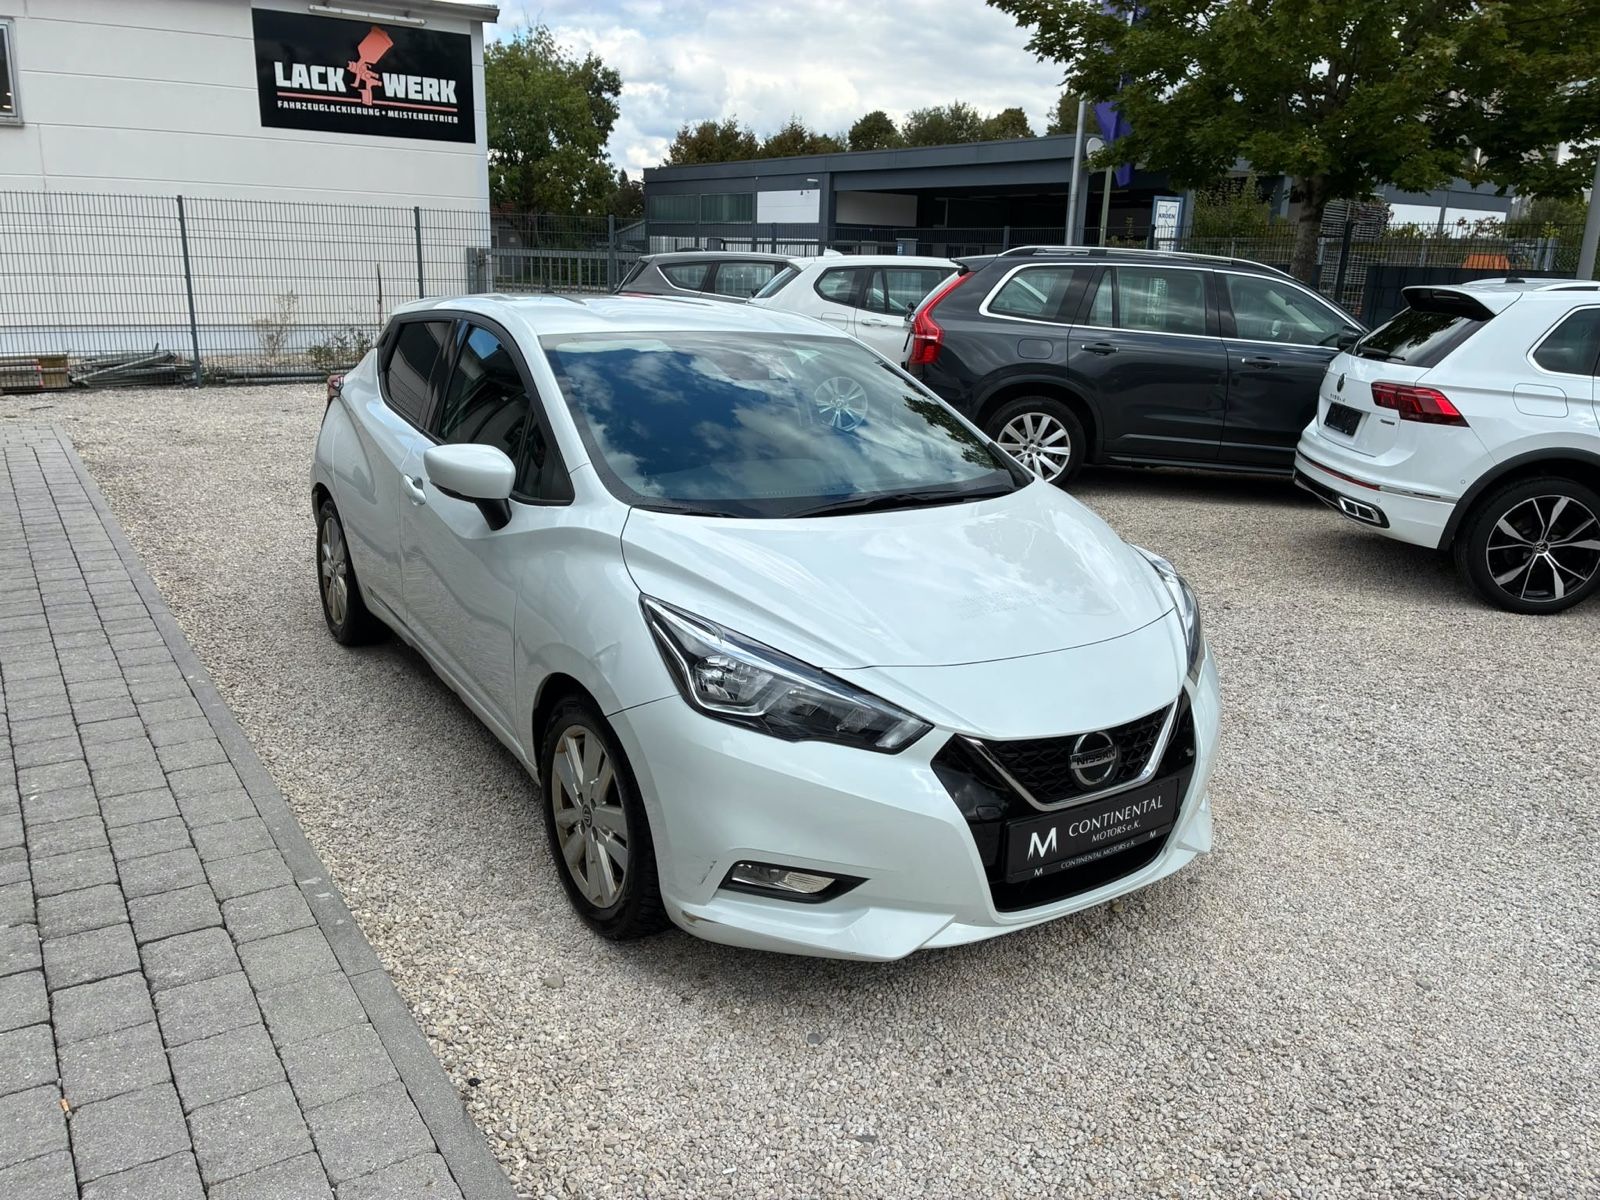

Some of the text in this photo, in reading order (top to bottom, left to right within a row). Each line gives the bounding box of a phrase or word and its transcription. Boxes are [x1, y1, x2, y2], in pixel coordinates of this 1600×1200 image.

[274, 61, 458, 104] LACK WERK
[277, 100, 459, 124] FAHRZEUGLACKIERUNG MEISTERBETRIEB
[1076, 748, 1116, 766] NISSAN
[1027, 795, 1164, 861] M CONTINENTAL
[1091, 823, 1126, 843] MOTORS
[1060, 851, 1102, 869] CONTINENTAL
[1103, 842, 1126, 857] MOTORS
